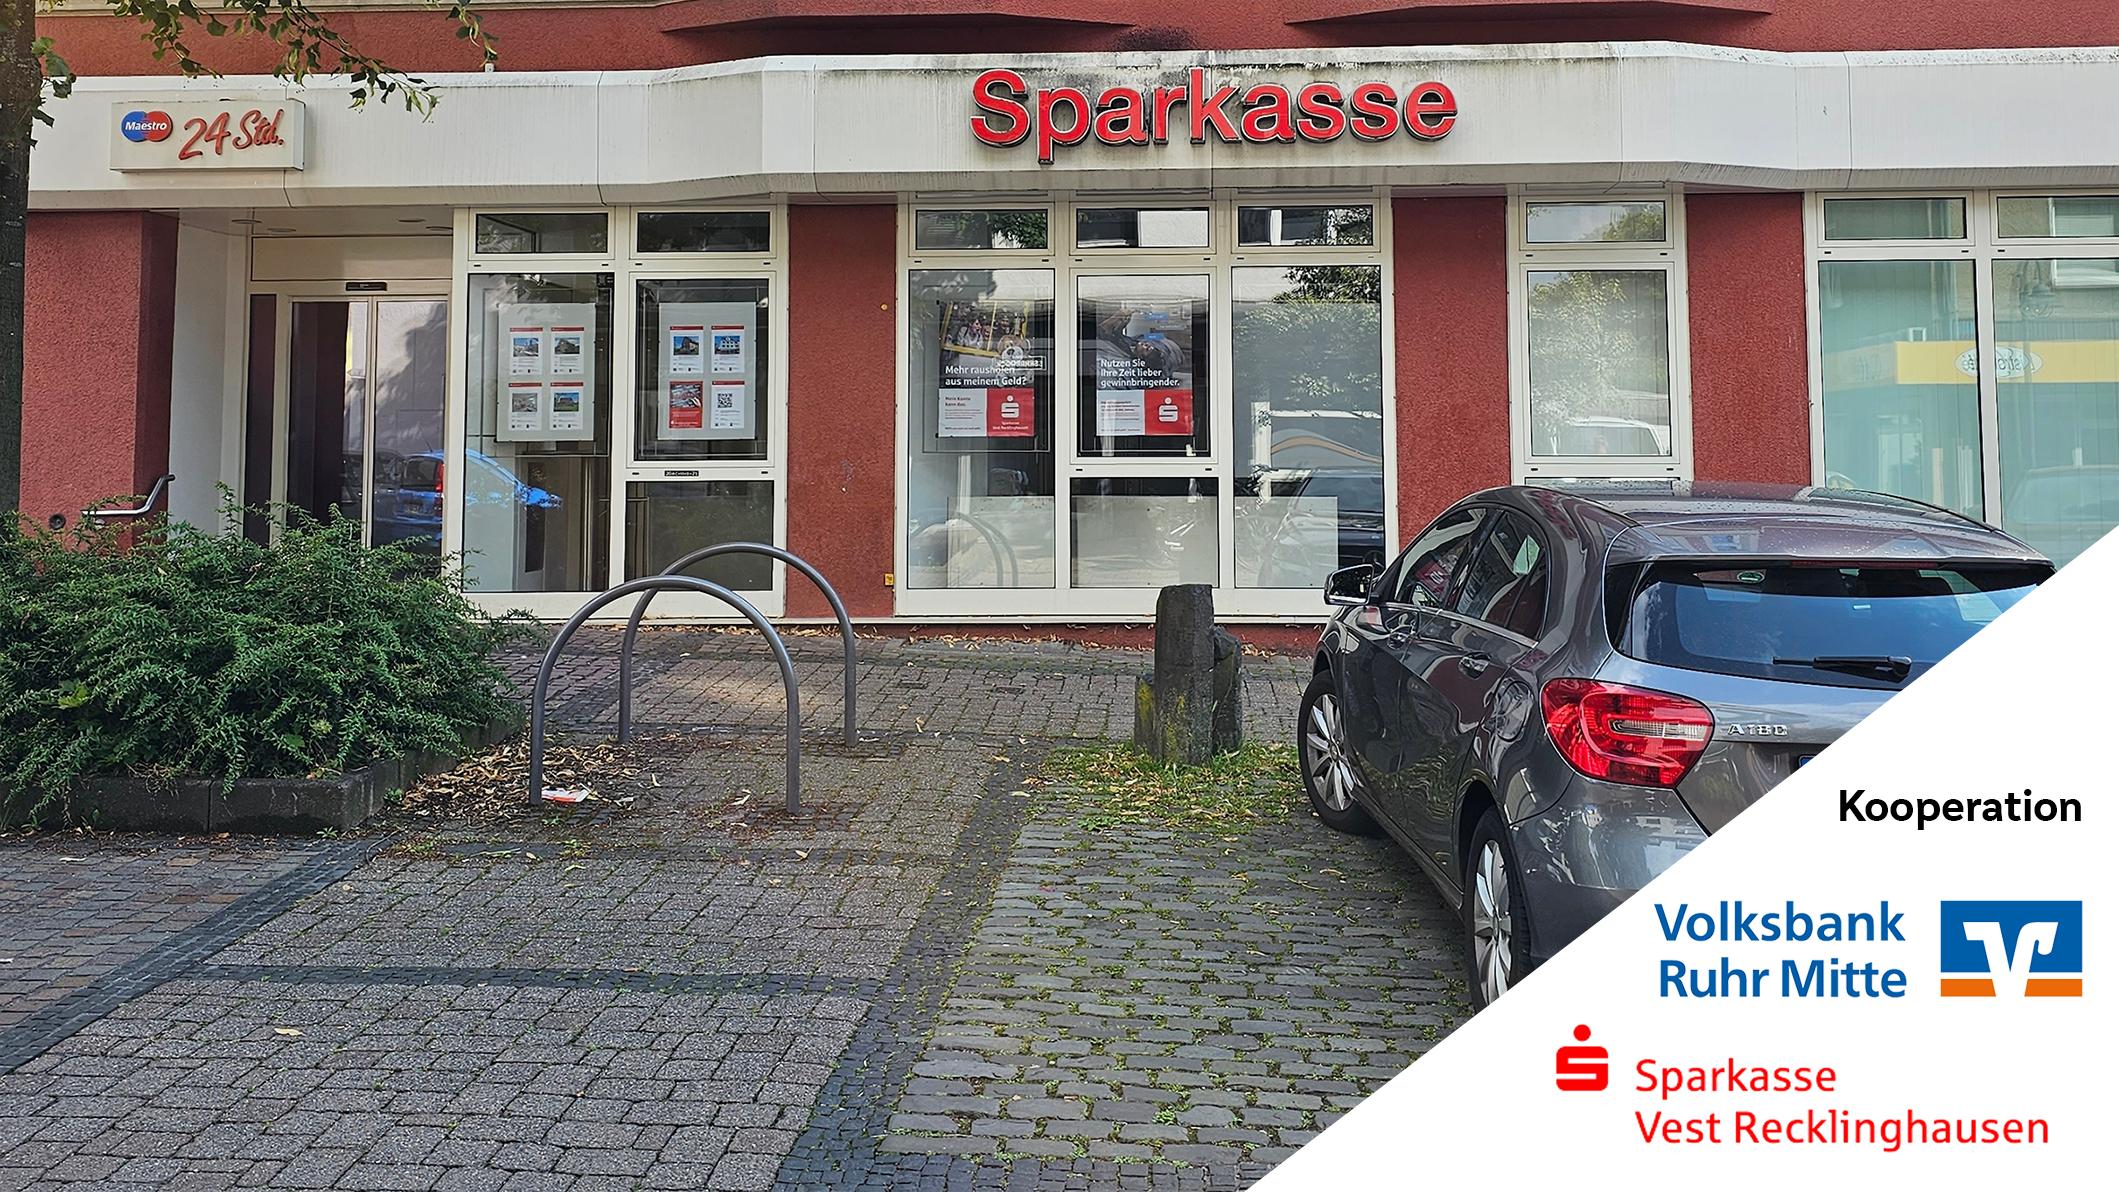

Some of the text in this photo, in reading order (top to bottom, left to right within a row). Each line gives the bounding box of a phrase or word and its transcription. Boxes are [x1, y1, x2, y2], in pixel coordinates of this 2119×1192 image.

[970, 67, 1458, 165] Sparkasse
[125, 121, 168, 131] Maestro
[178, 109, 285, 161] 24 Std.
[1101, 358, 1146, 367] Nutzen Sie
[945, 365, 970, 374] Mehr
[1101, 368, 1162, 377] Ihre Zeit lieber
[945, 376, 1027, 386] aus meinem Geld?
[1101, 378, 1180, 388] gewinnbringender.
